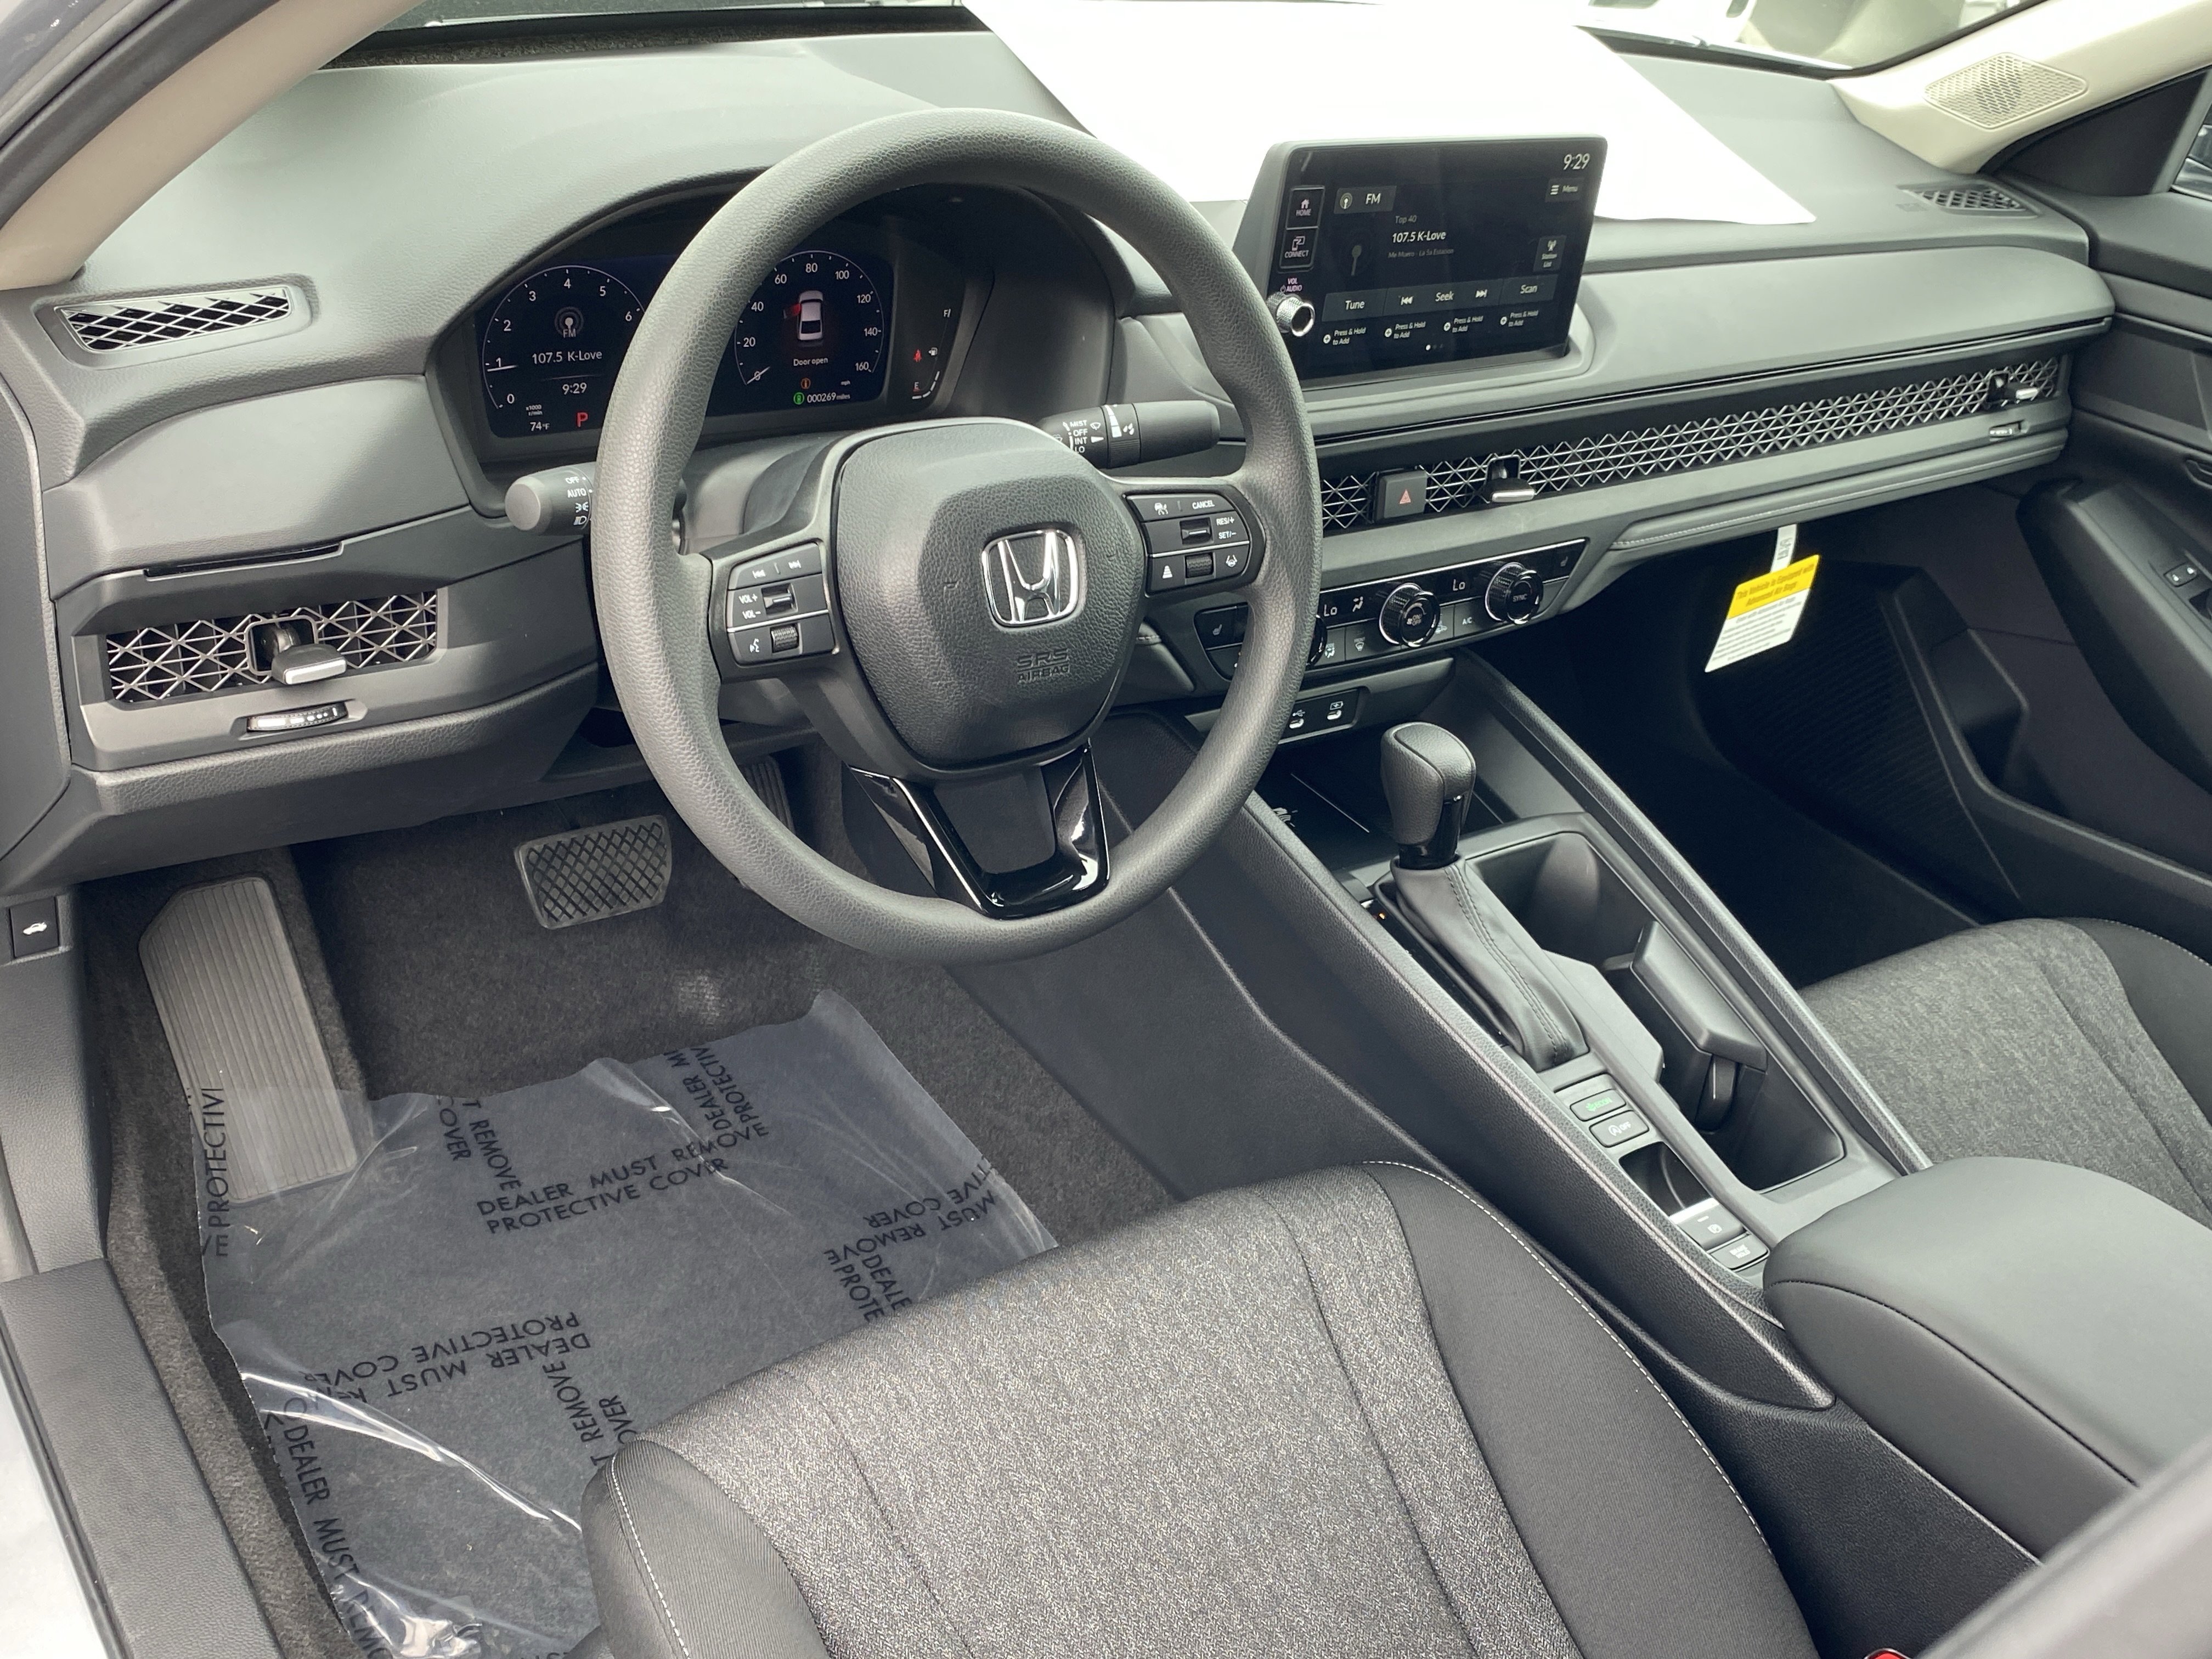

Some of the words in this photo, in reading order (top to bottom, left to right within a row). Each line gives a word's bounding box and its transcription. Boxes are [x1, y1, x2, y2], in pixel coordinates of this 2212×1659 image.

[1564, 153, 1590, 170] 9:29
[1365, 193, 1381, 205] FM
[1395, 215, 1407, 224] Top
[1392, 231, 1416, 243] 107.5
[1417, 230, 1447, 241] K-Love
[1284, 250, 1309, 258] CONNECT
[805, 263, 817, 273] 80
[774, 274, 787, 284] 60
[835, 270, 849, 280] 100
[563, 279, 571, 288] 4
[599, 286, 606, 296] 5
[1520, 284, 1538, 294] Scan
[529, 291, 536, 301] 3
[857, 294, 871, 303] 120
[1435, 291, 1454, 302] Seek
[751, 302, 764, 312] 40
[1345, 300, 1365, 310] Tune
[625, 311, 631, 321] 6
[504, 320, 511, 331] 2
[563, 329, 576, 338] FM
[864, 327, 878, 336] 140
[743, 337, 755, 347] 20
[532, 352, 562, 364] 107.5
[568, 350, 602, 362] K-Love
[496, 358, 501, 367] 1
[855, 362, 869, 371] 160
[562, 382, 586, 394] 9:29
[507, 394, 515, 403] 0
[807, 392, 836, 403] 000269
[577, 412, 588, 427] P
[1070, 420, 1087, 428] MIST
[1073, 428, 1088, 437] OFF
[565, 476, 579, 484] OFF
[567, 488, 586, 498] AUTO
[1192, 500, 1215, 510] CANCEL
[1452, 579, 1466, 591] Lo
[1513, 594, 1528, 602] SYNC
[1323, 604, 1338, 617] Lo
[1462, 617, 1472, 625] A/C
[1017, 648, 1069, 668] SRS
[1017, 664, 1069, 683] AIRBAG
[682, 1074, 732, 1131] DEALER
[1619, 1121, 1631, 1131] OFF
[469, 1119, 523, 1192] REMOVE
[477, 1183, 574, 1216] DEALER
[589, 1155, 658, 1189] MUST
[671, 1121, 769, 1161] REMOVE
[487, 1184, 641, 1234] PROTECTIVE
[650, 1158, 729, 1190] COVER
[862, 1198, 941, 1228] COVER
[937, 1189, 996, 1231] MUST
[823, 1223, 927, 1265] REMOVE
[411, 1312, 579, 1363] PROTECTIVE
[486, 1333, 591, 1368] DEALER
[303, 1356, 399, 1386] COVER
[387, 1359, 466, 1397] MUST
[542, 1361, 604, 1443] REMOVE
[283, 1425, 330, 1505] DEALER
[313, 1518, 360, 1581] MUST
